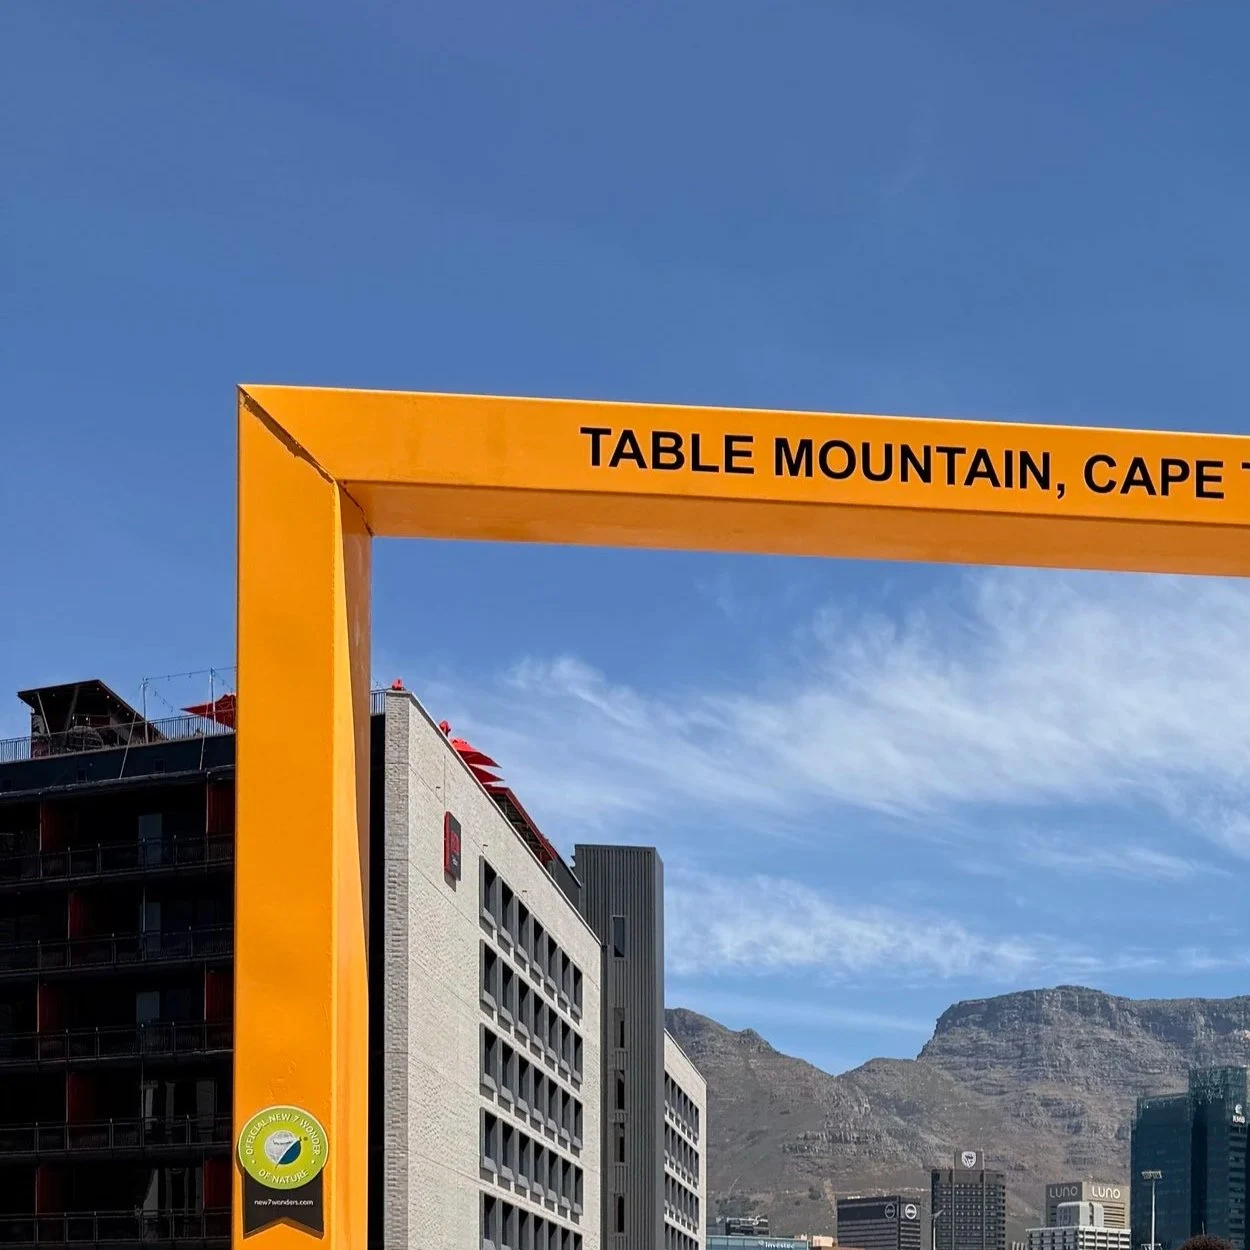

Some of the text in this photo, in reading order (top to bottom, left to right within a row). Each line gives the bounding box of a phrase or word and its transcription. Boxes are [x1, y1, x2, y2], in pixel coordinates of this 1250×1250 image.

[581, 428, 754, 473] TABLE
[775, 438, 1064, 498] MOUNTAIN,
[1085, 455, 1224, 498] CAPE
[246, 1113, 321, 1155] OFFICIAL NEW 7 WONDER
[257, 1168, 310, 1184] OF NATURE
[253, 1198, 314, 1206] new7wonders.com
